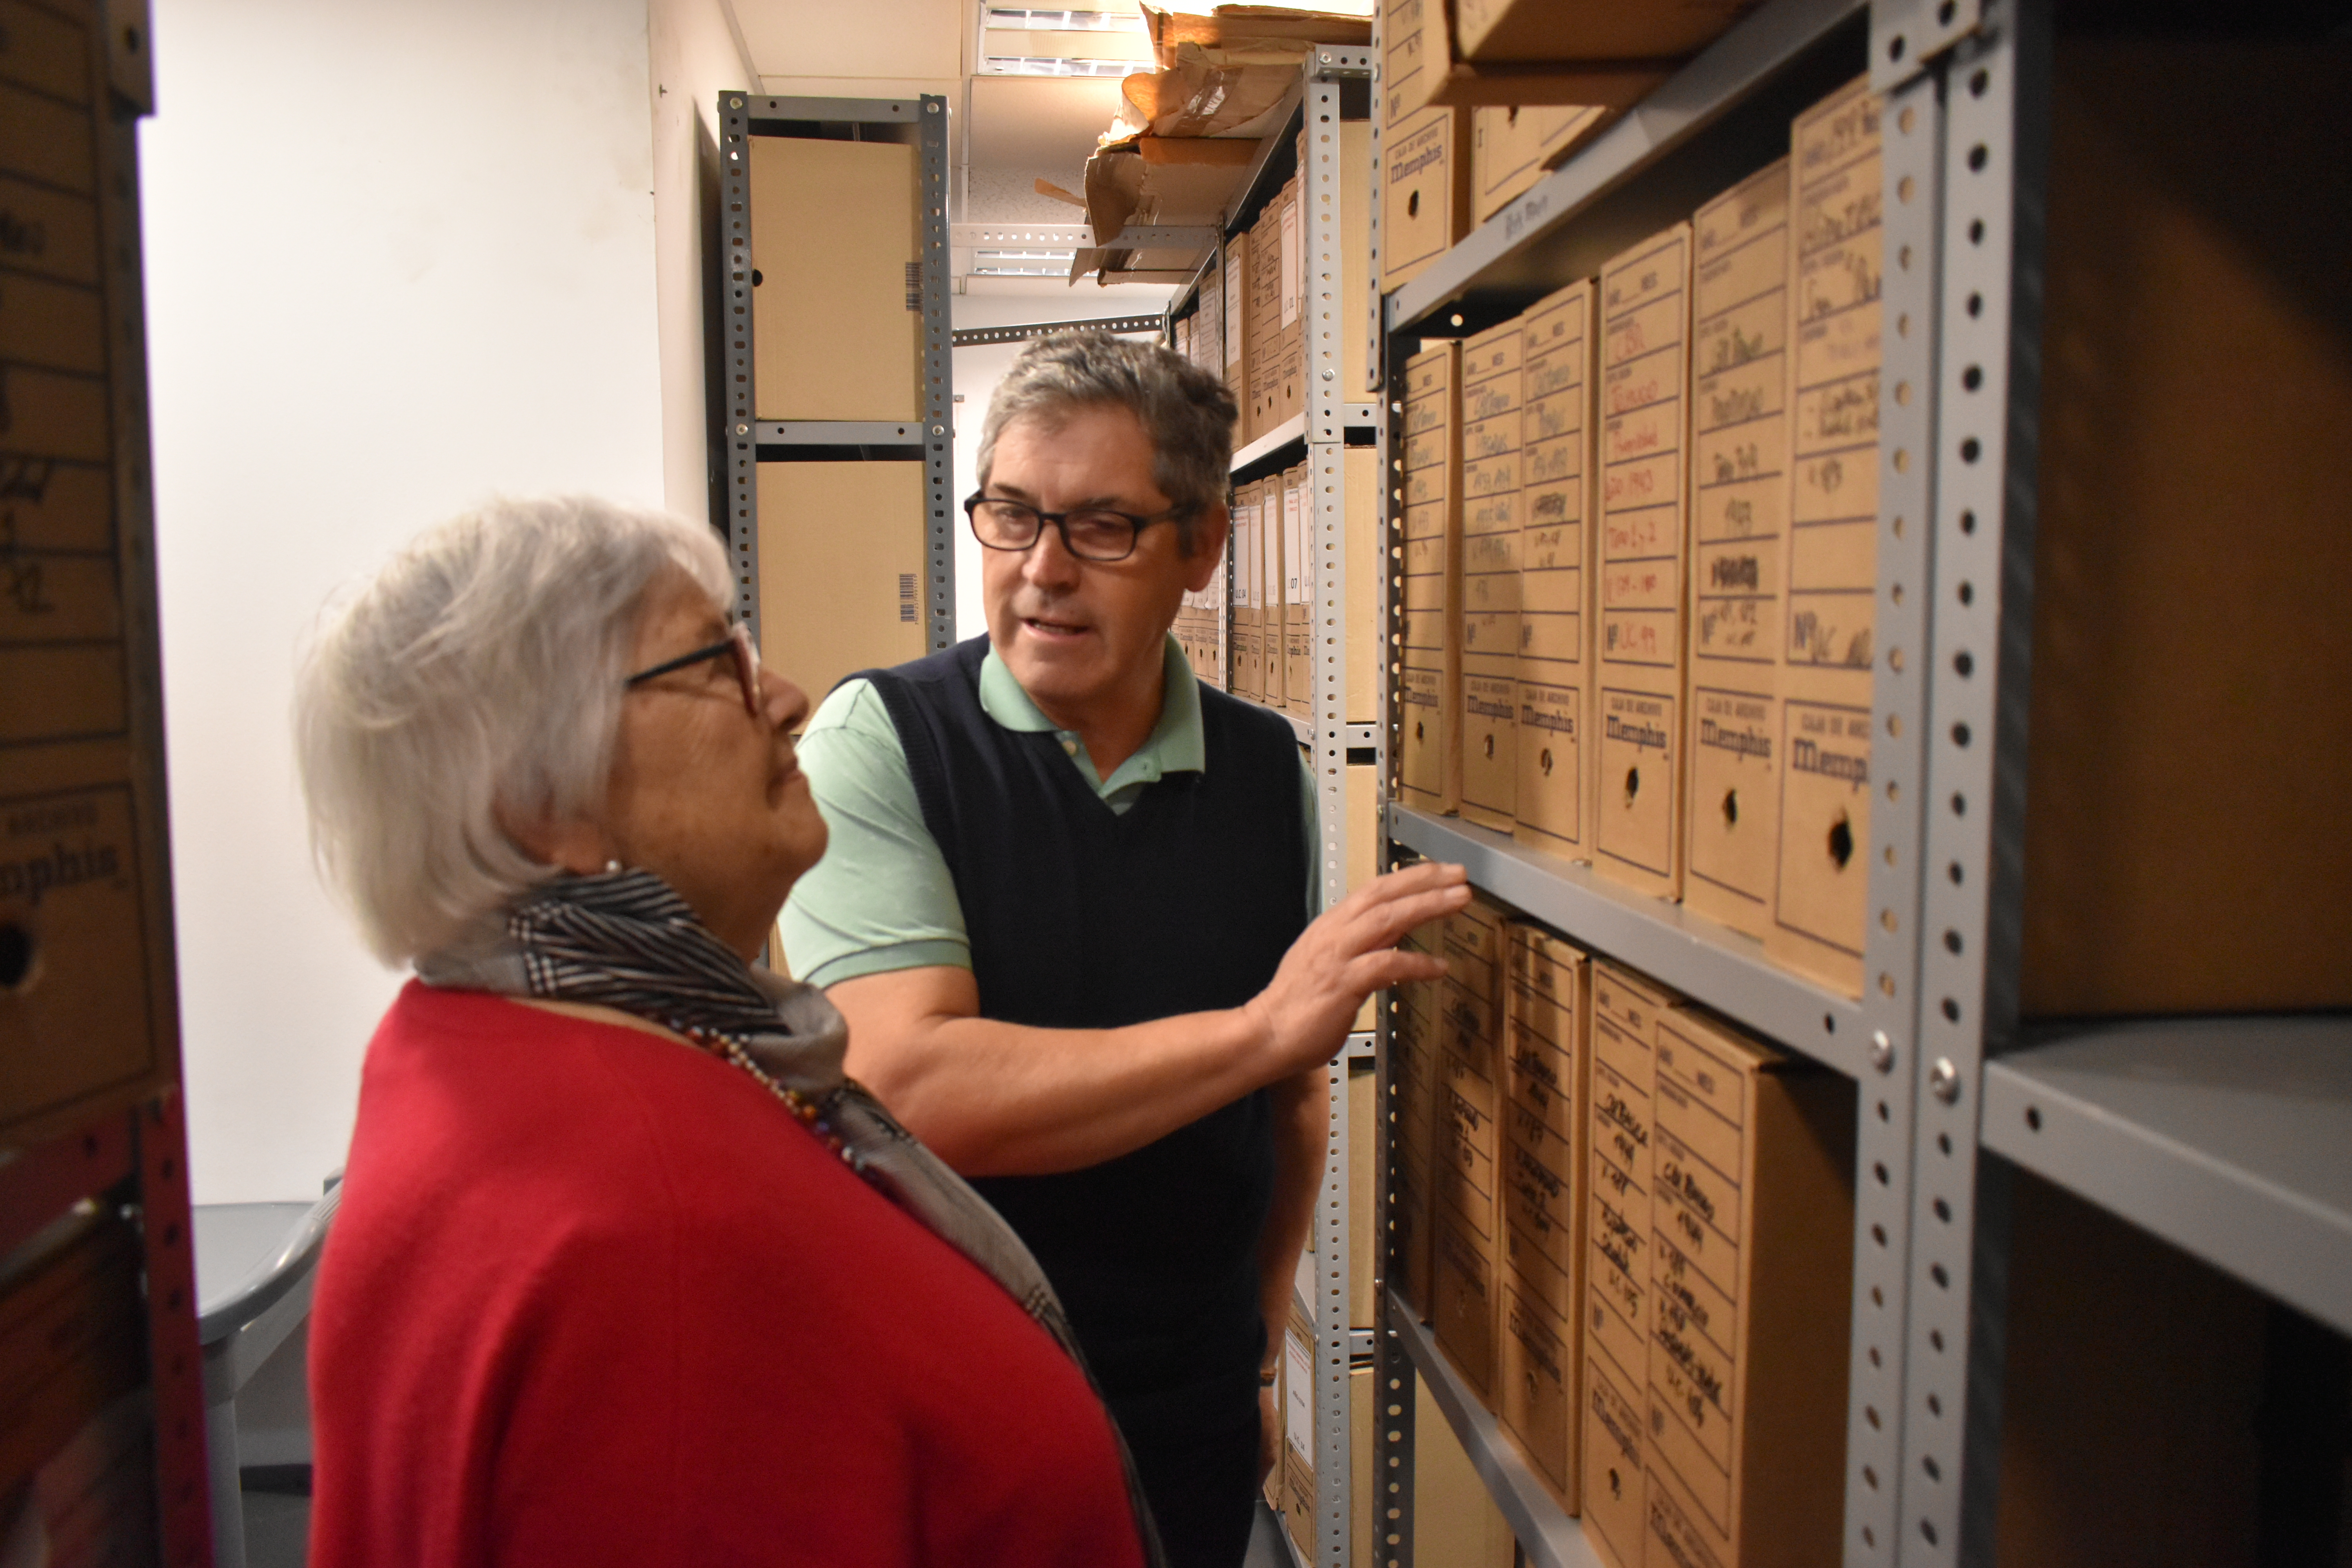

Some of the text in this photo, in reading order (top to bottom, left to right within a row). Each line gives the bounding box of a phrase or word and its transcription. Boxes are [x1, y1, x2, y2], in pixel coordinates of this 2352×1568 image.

[1391, 144, 1442, 184] Memphis
[1291, 578, 1298, 589] 07
[1467, 695, 1514, 724] Memphis
[1522, 704, 1573, 738] Memphis
[1607, 714, 1666, 753] Memphis
[1701, 718, 1771, 762] Memphis
